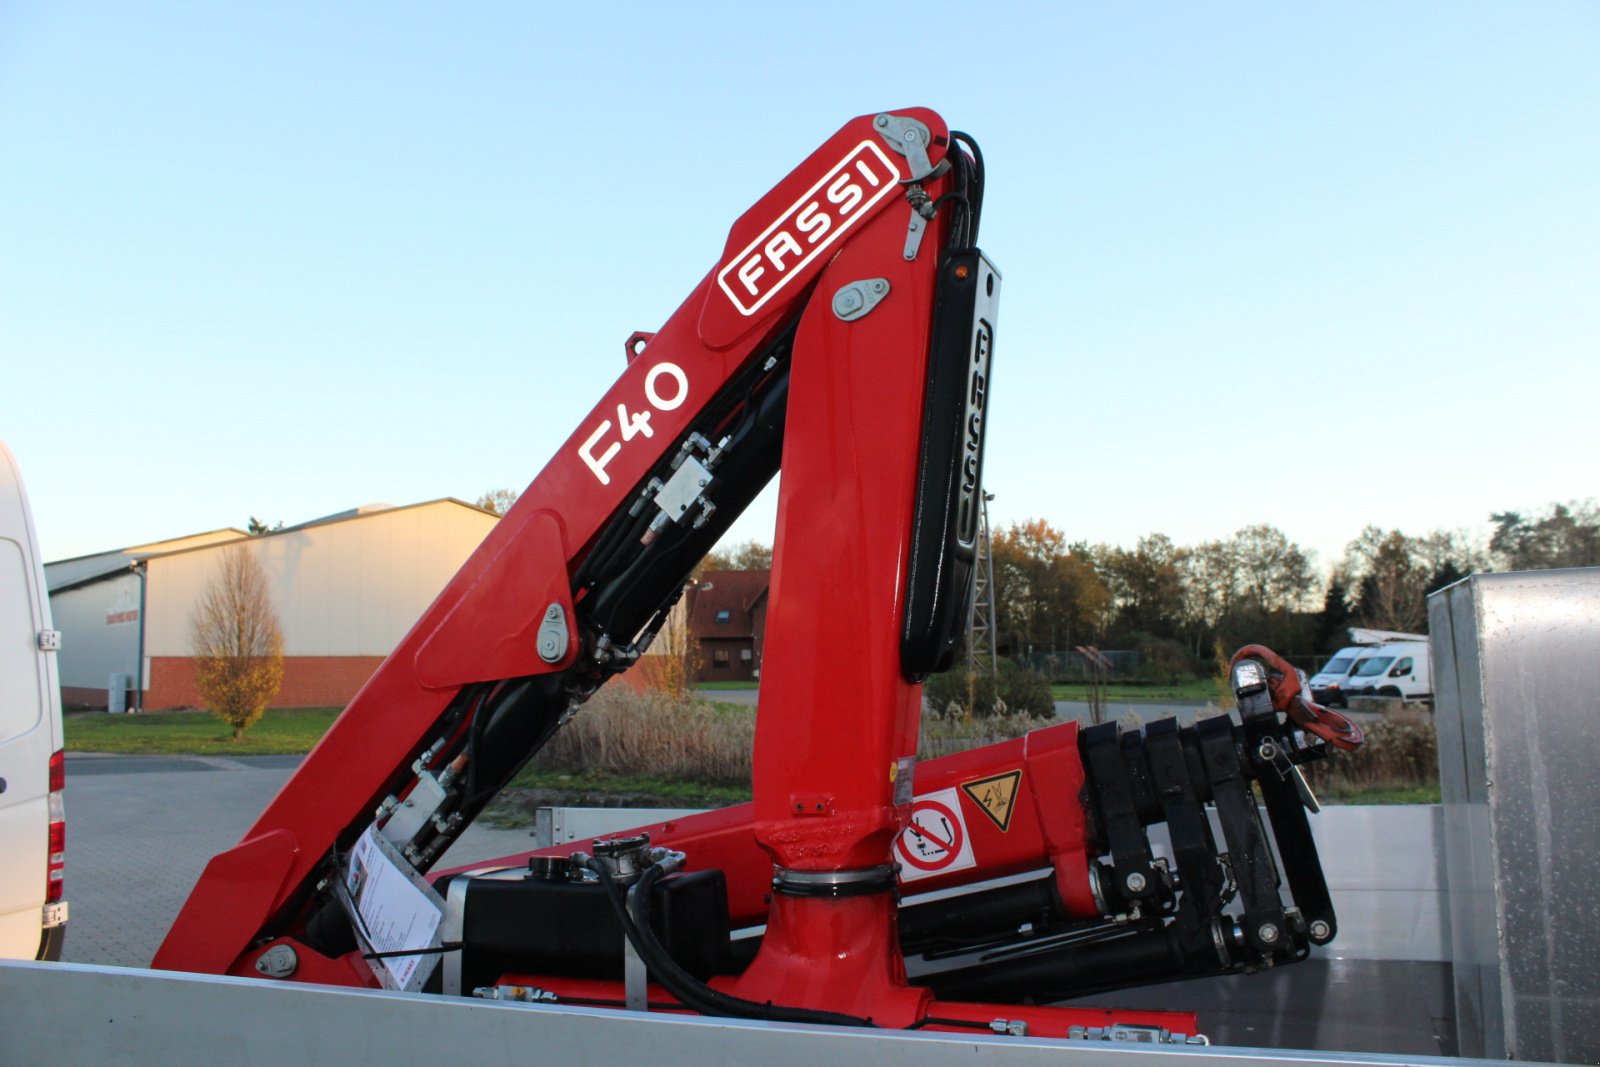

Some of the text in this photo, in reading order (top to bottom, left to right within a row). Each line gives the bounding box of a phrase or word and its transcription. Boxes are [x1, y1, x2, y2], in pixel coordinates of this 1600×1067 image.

[738, 159, 881, 297] FASSI
[577, 361, 689, 486] F40
[961, 328, 988, 535] FASSI
